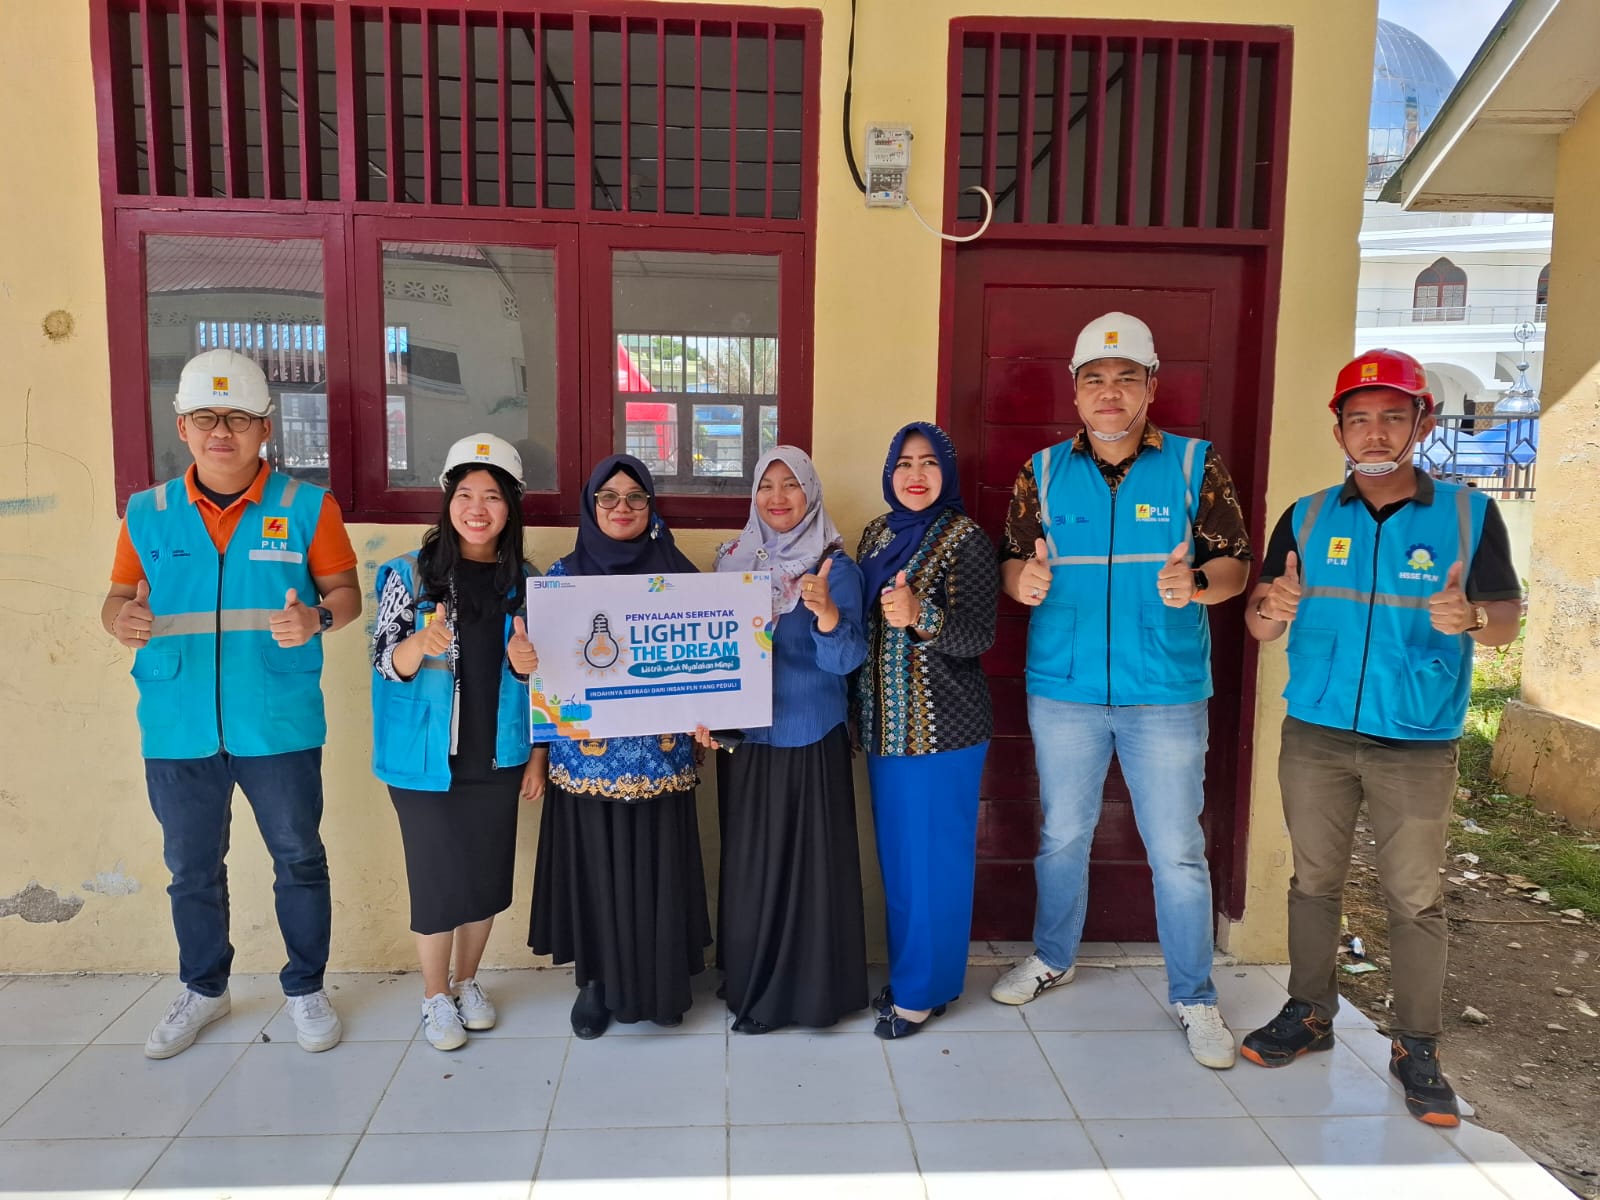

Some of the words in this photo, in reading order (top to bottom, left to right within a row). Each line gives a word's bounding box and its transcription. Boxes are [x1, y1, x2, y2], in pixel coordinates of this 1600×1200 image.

[1150, 506, 1169, 516] PLN
[262, 540, 287, 550] PLN
[1327, 558, 1348, 566] PLN
[625, 612, 683, 621] PENYALAAN
[685, 609, 735, 619] SERENTAK
[630, 622, 702, 644] LIGHT
[708, 620, 739, 640] UP
[630, 645, 668, 661] THE
[671, 641, 738, 660] DREAM
[641, 665, 662, 673] Listrik
[663, 664, 681, 672] untuk
[682, 662, 714, 673] Nyalakan
[623, 688, 650, 696] BERBAGI
